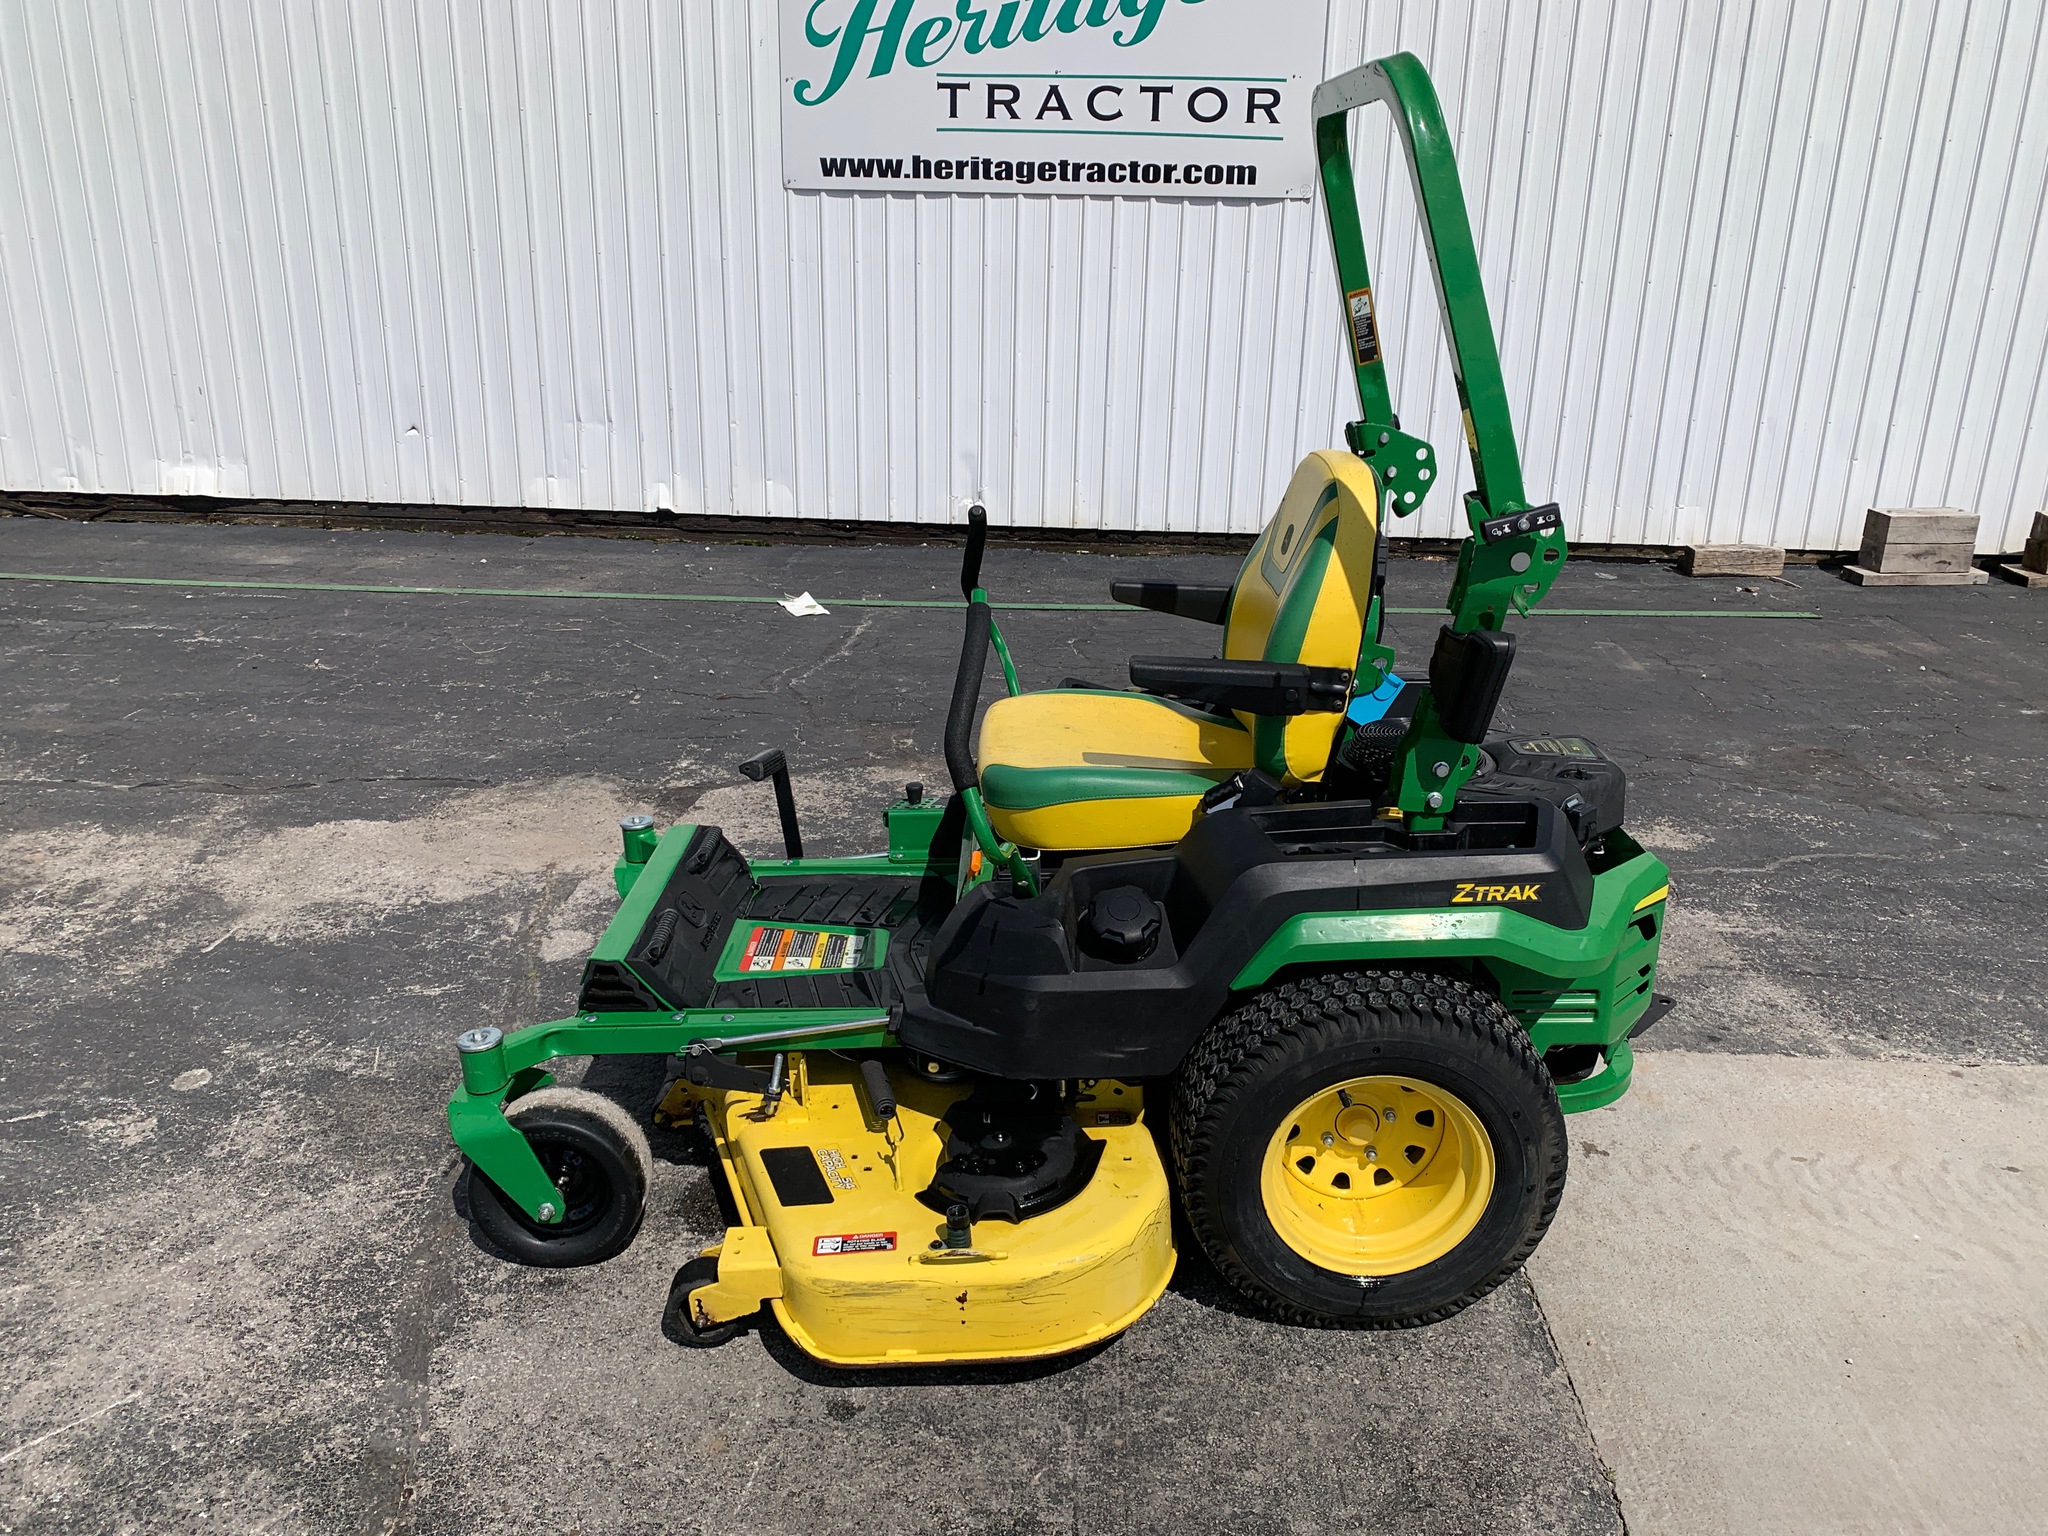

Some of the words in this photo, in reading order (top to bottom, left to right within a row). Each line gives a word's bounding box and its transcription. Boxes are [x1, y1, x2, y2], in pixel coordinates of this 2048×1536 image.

[793, 0, 1207, 106] Heritag
[936, 82, 1281, 125] TRACTOR
[819, 155, 1257, 186] www.heritagetractor.com
[1451, 883, 1541, 903] ZTRAK
[816, 1148, 846, 1189] CAPACITY
[828, 1149, 847, 1169] HIGH
[841, 1176, 857, 1190] 54
